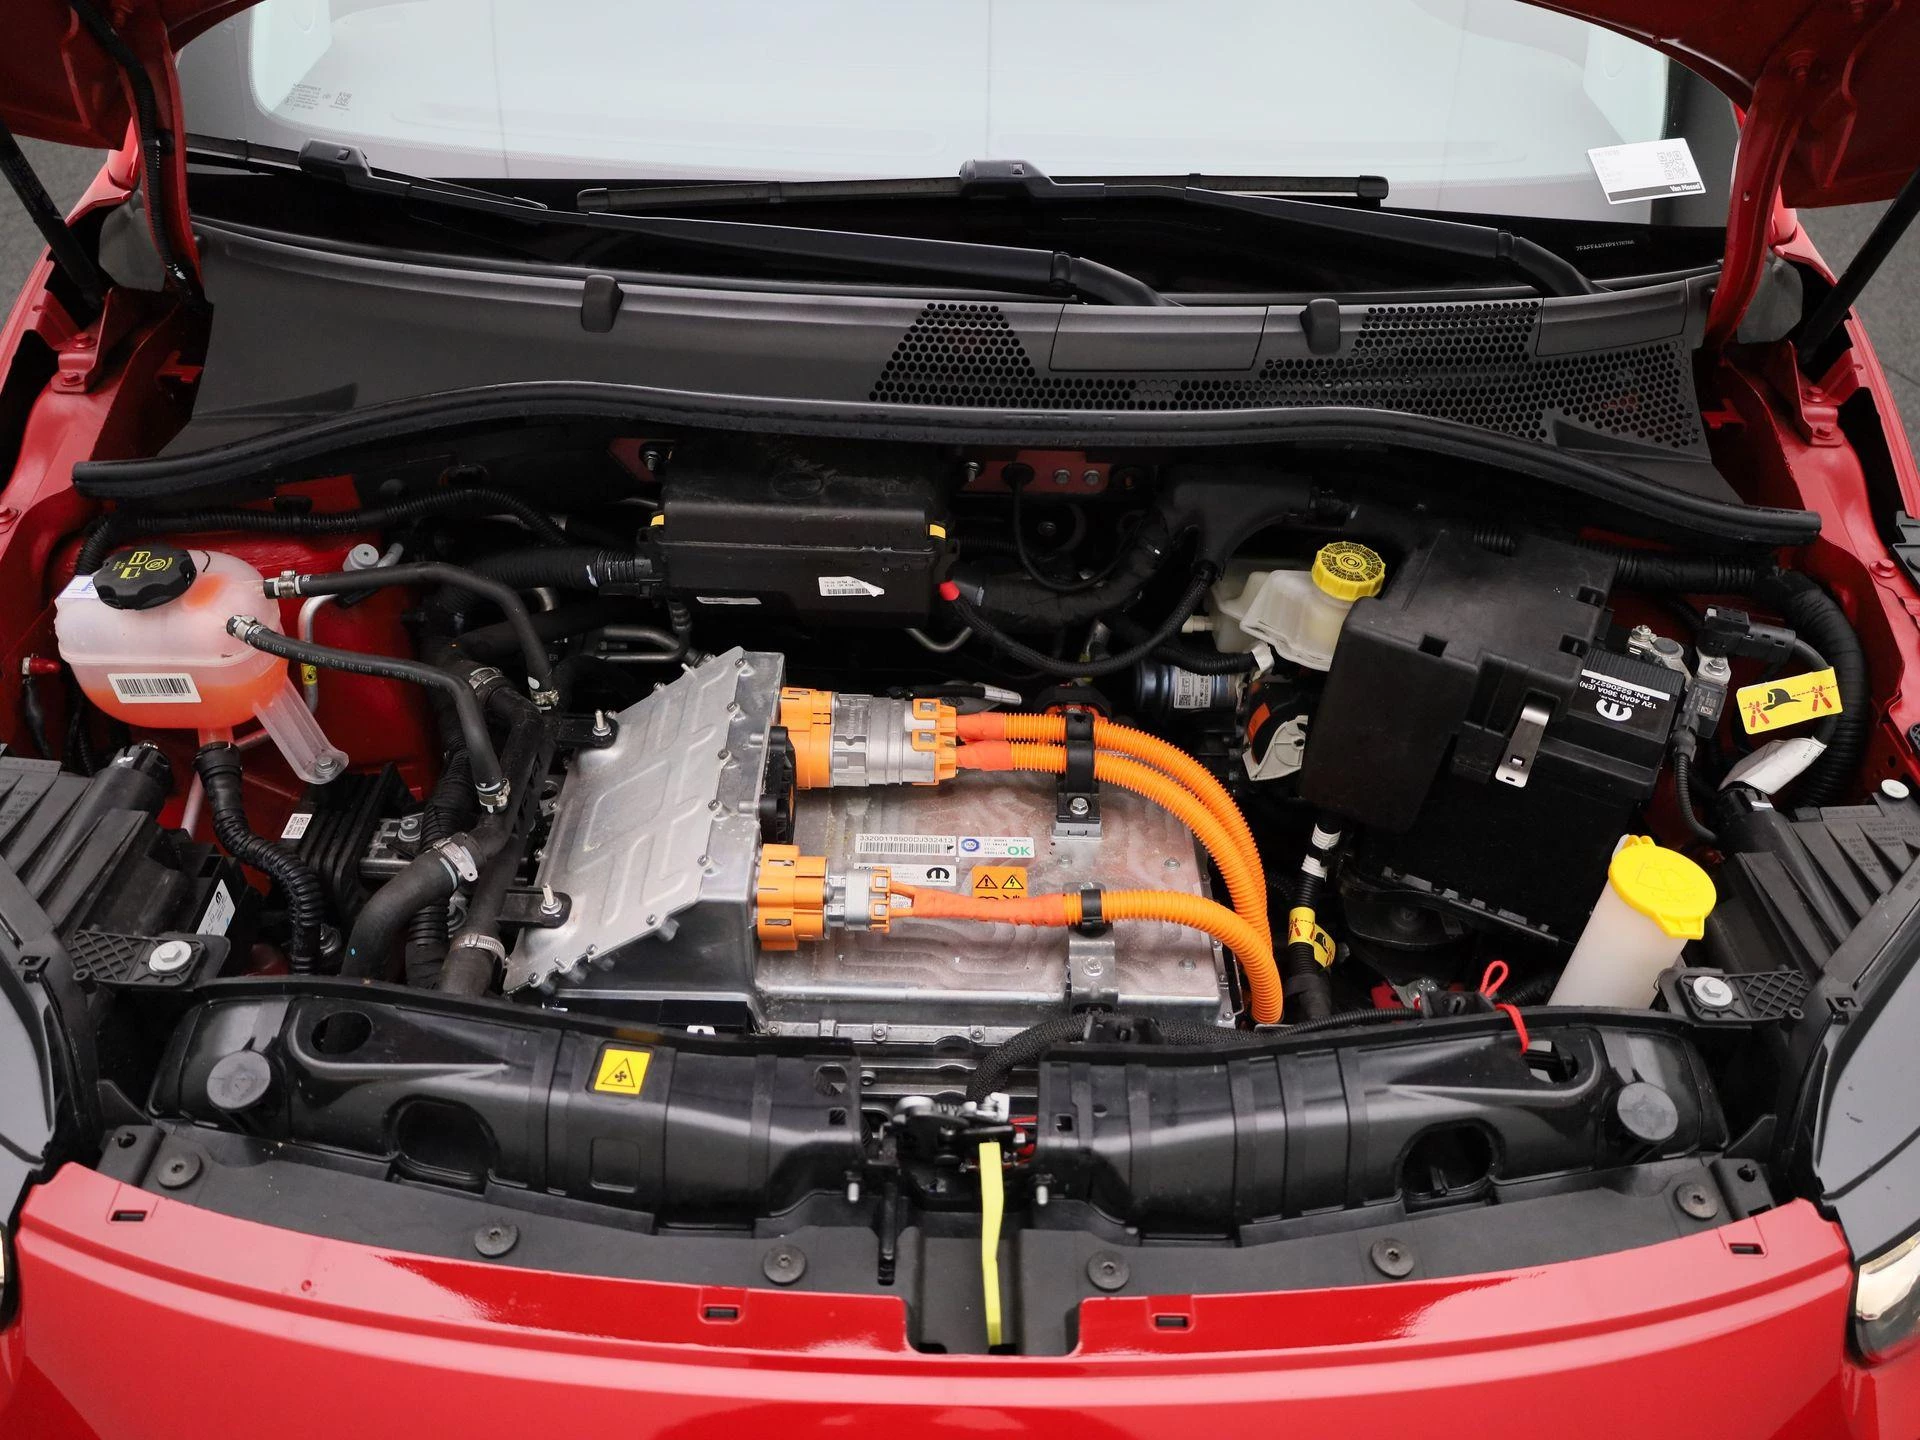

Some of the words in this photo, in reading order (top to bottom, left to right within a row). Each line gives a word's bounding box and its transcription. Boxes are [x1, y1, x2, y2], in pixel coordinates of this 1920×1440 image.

[1619, 694, 1641, 704] 40Ah
[1641, 700, 1657, 710] 12V
[1007, 846, 1031, 856] OK
